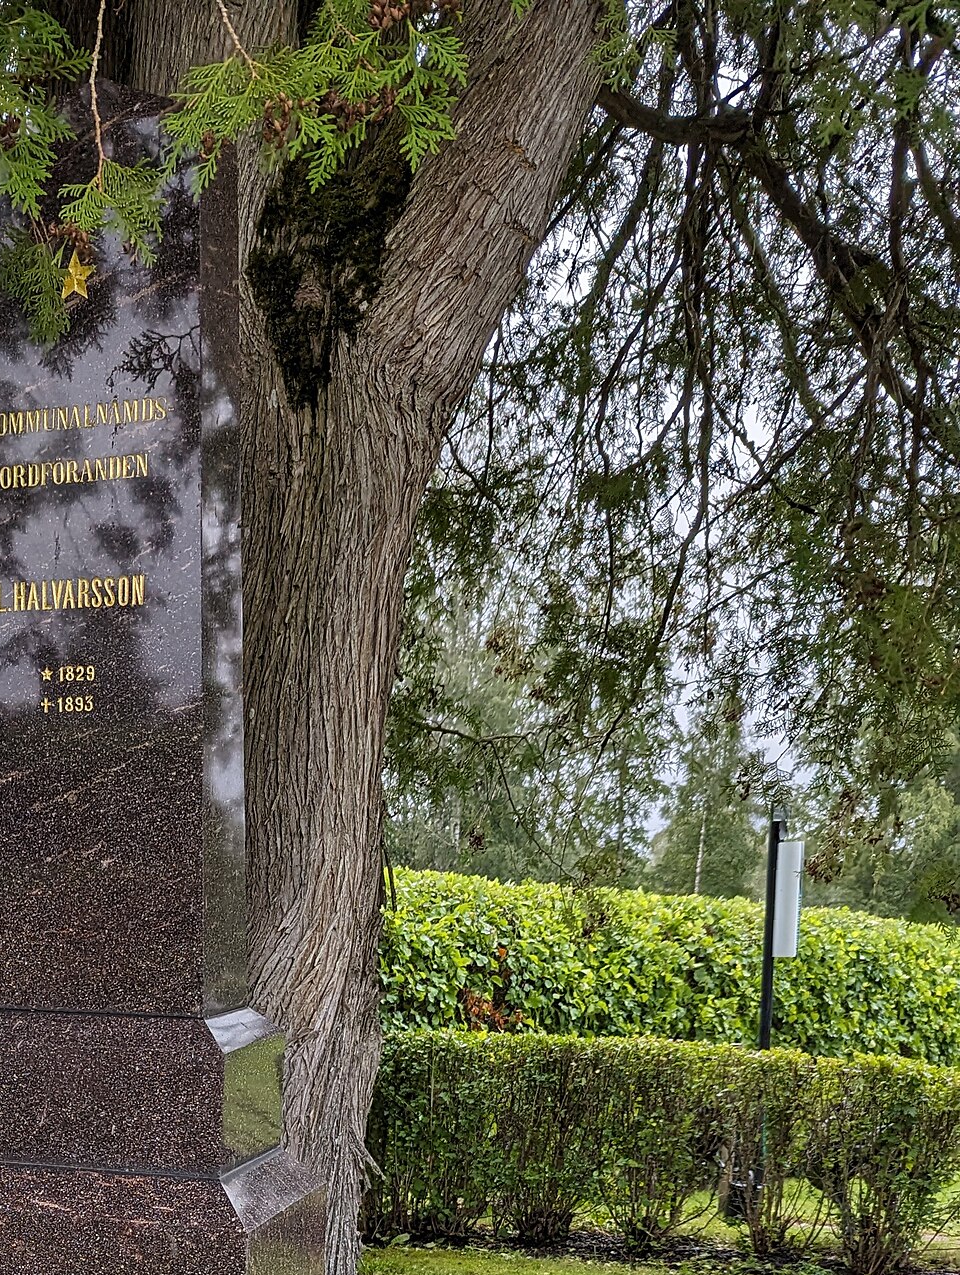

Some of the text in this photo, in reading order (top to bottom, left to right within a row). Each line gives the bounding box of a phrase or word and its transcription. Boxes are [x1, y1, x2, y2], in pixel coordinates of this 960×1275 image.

[0, 453, 150, 490] ORDFÖRANDEN
[58, 665, 95, 682] 1829
[56, 695, 94, 713] 1893
